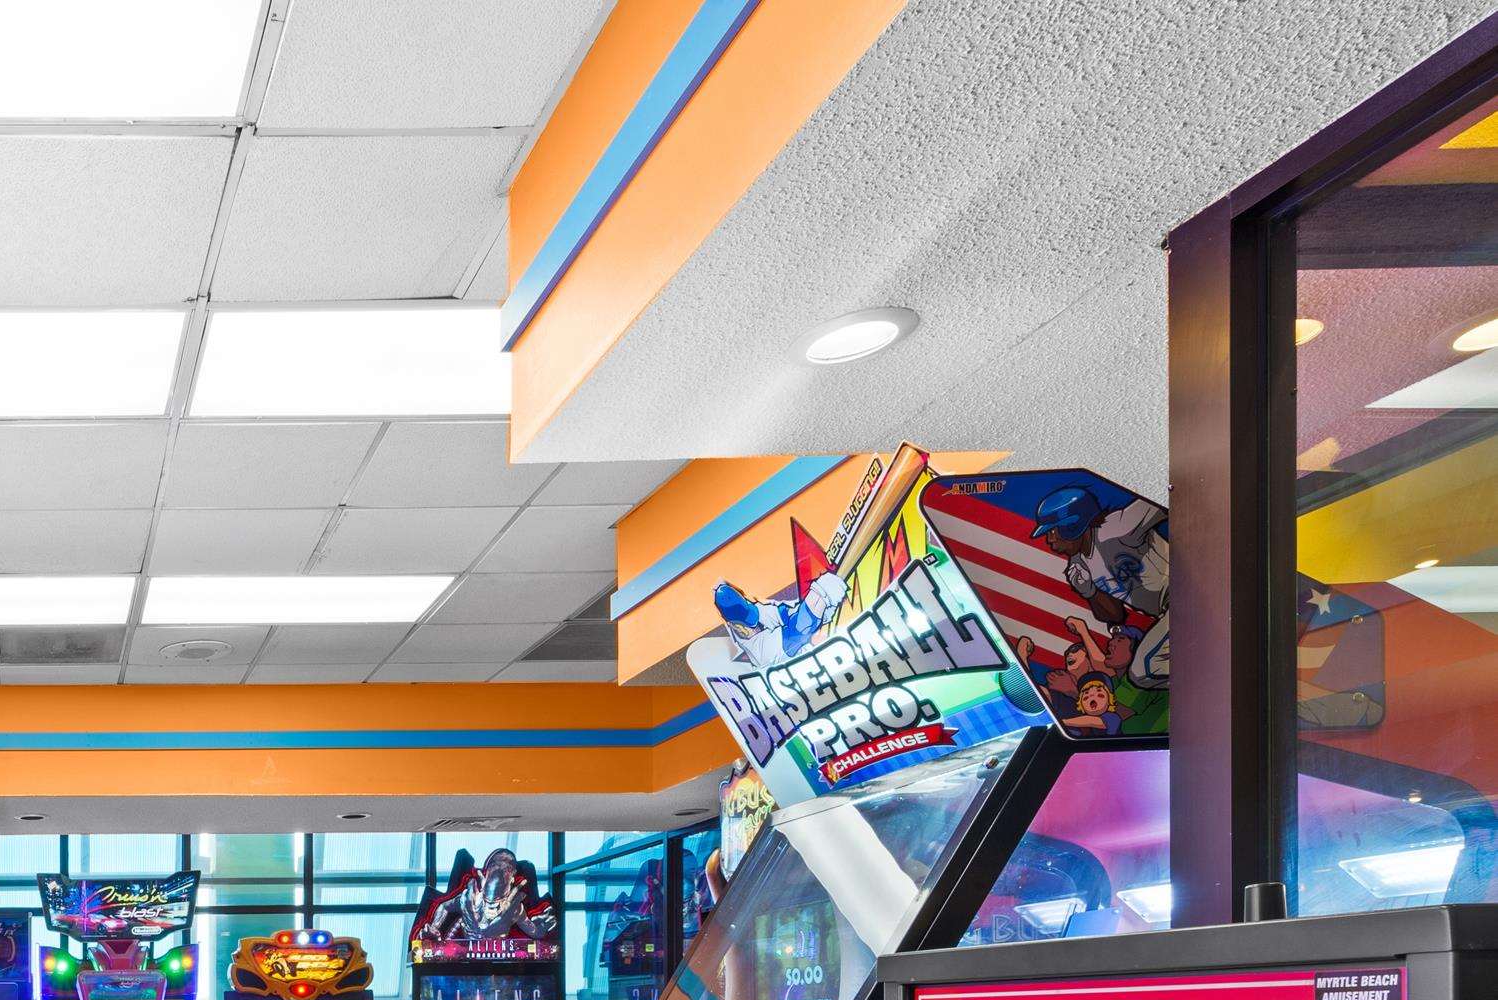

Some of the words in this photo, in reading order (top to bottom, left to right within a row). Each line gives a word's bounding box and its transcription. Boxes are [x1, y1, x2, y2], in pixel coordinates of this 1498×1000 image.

[951, 481, 1004, 495] ANDAMIRO
[826, 531, 846, 564] REAL
[709, 562, 1008, 766] BASEBALL
[801, 684, 936, 760] PRO.
[831, 732, 928, 775] CHALLENGE
[117, 907, 163, 918] blast
[468, 940, 514, 951] ALIENS
[786, 965, 823, 986] $0.00
[1317, 976, 1358, 988] MYRTLE
[1361, 974, 1398, 986] BEACH
